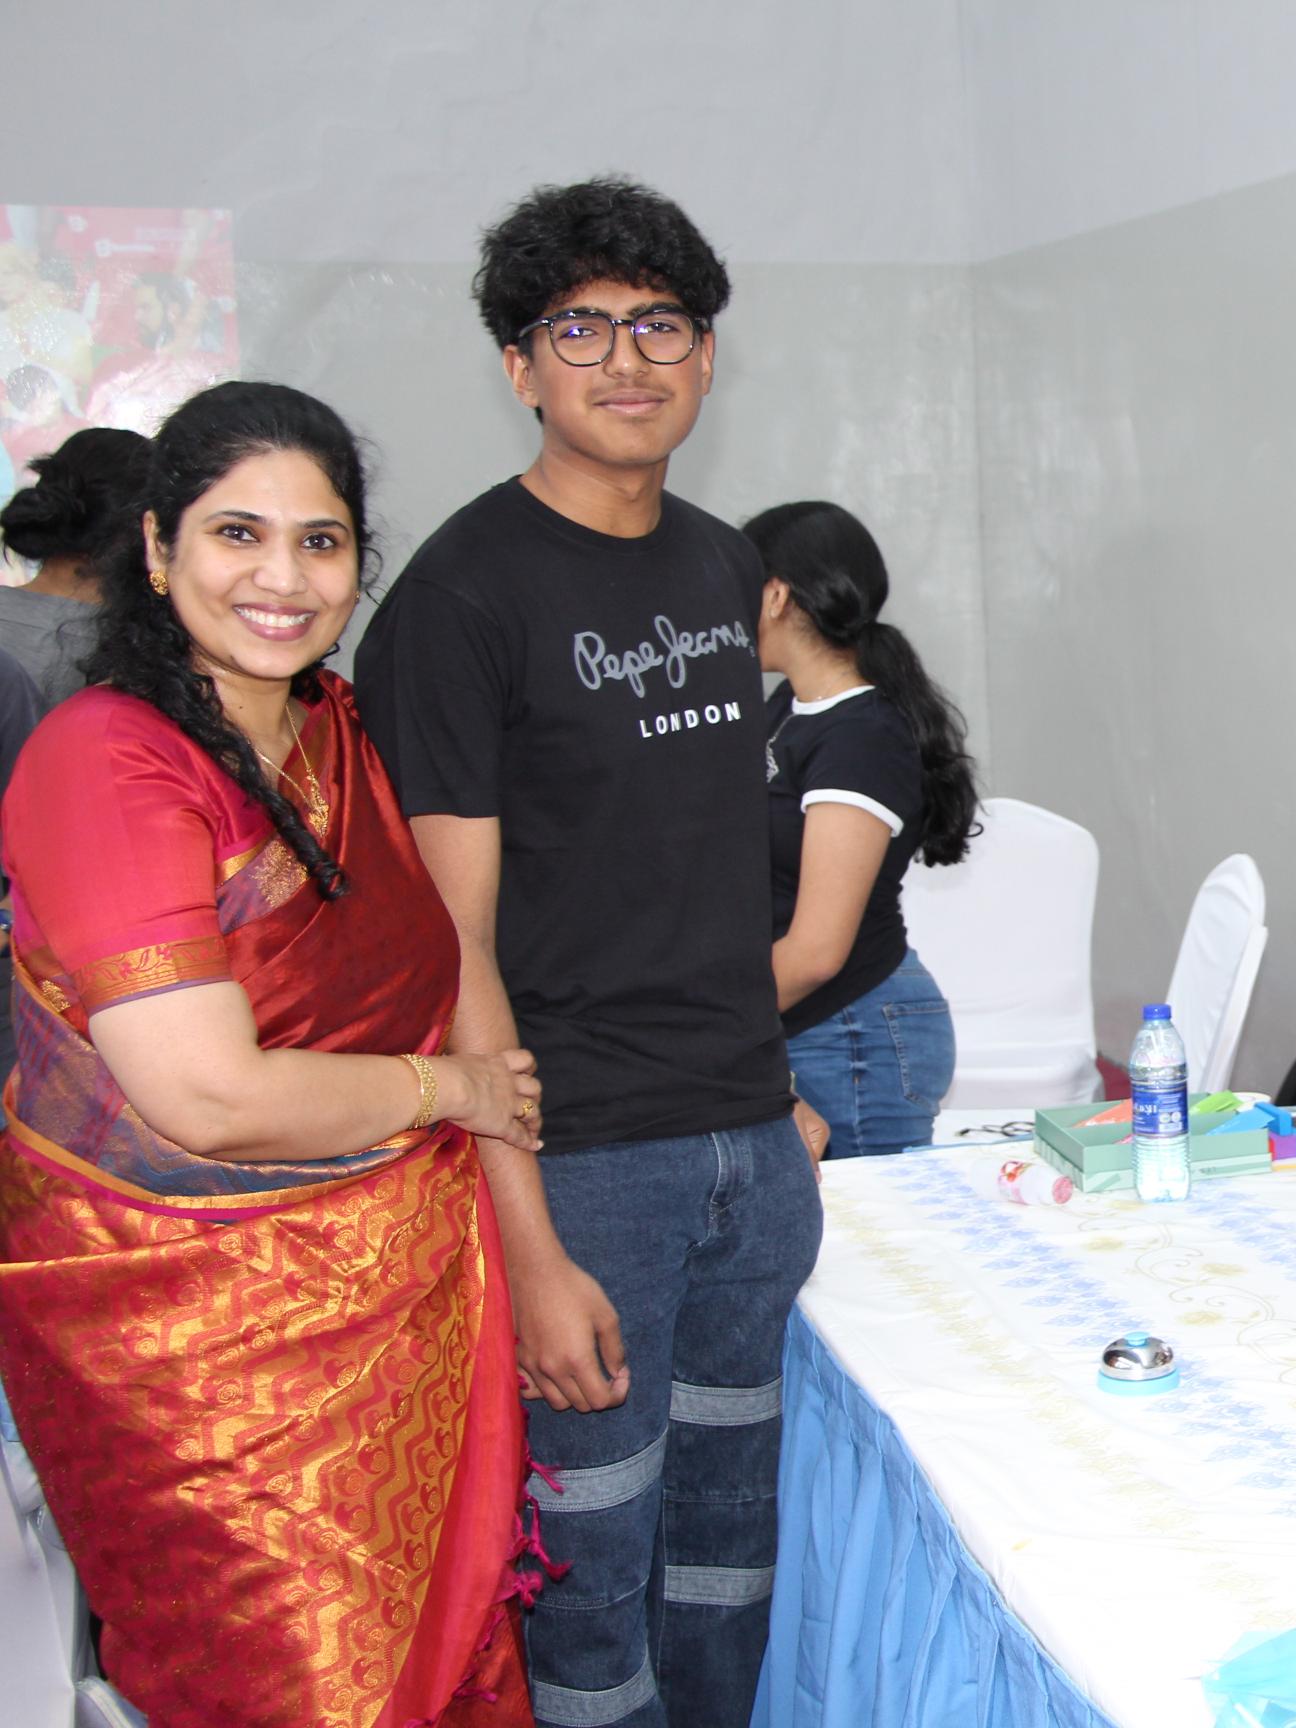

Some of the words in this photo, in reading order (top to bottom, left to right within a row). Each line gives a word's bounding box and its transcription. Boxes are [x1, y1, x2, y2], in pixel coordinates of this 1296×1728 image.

[574, 631, 663, 698] Pepe
[654, 615, 749, 688] Jeans
[640, 702, 742, 738] LONDON
